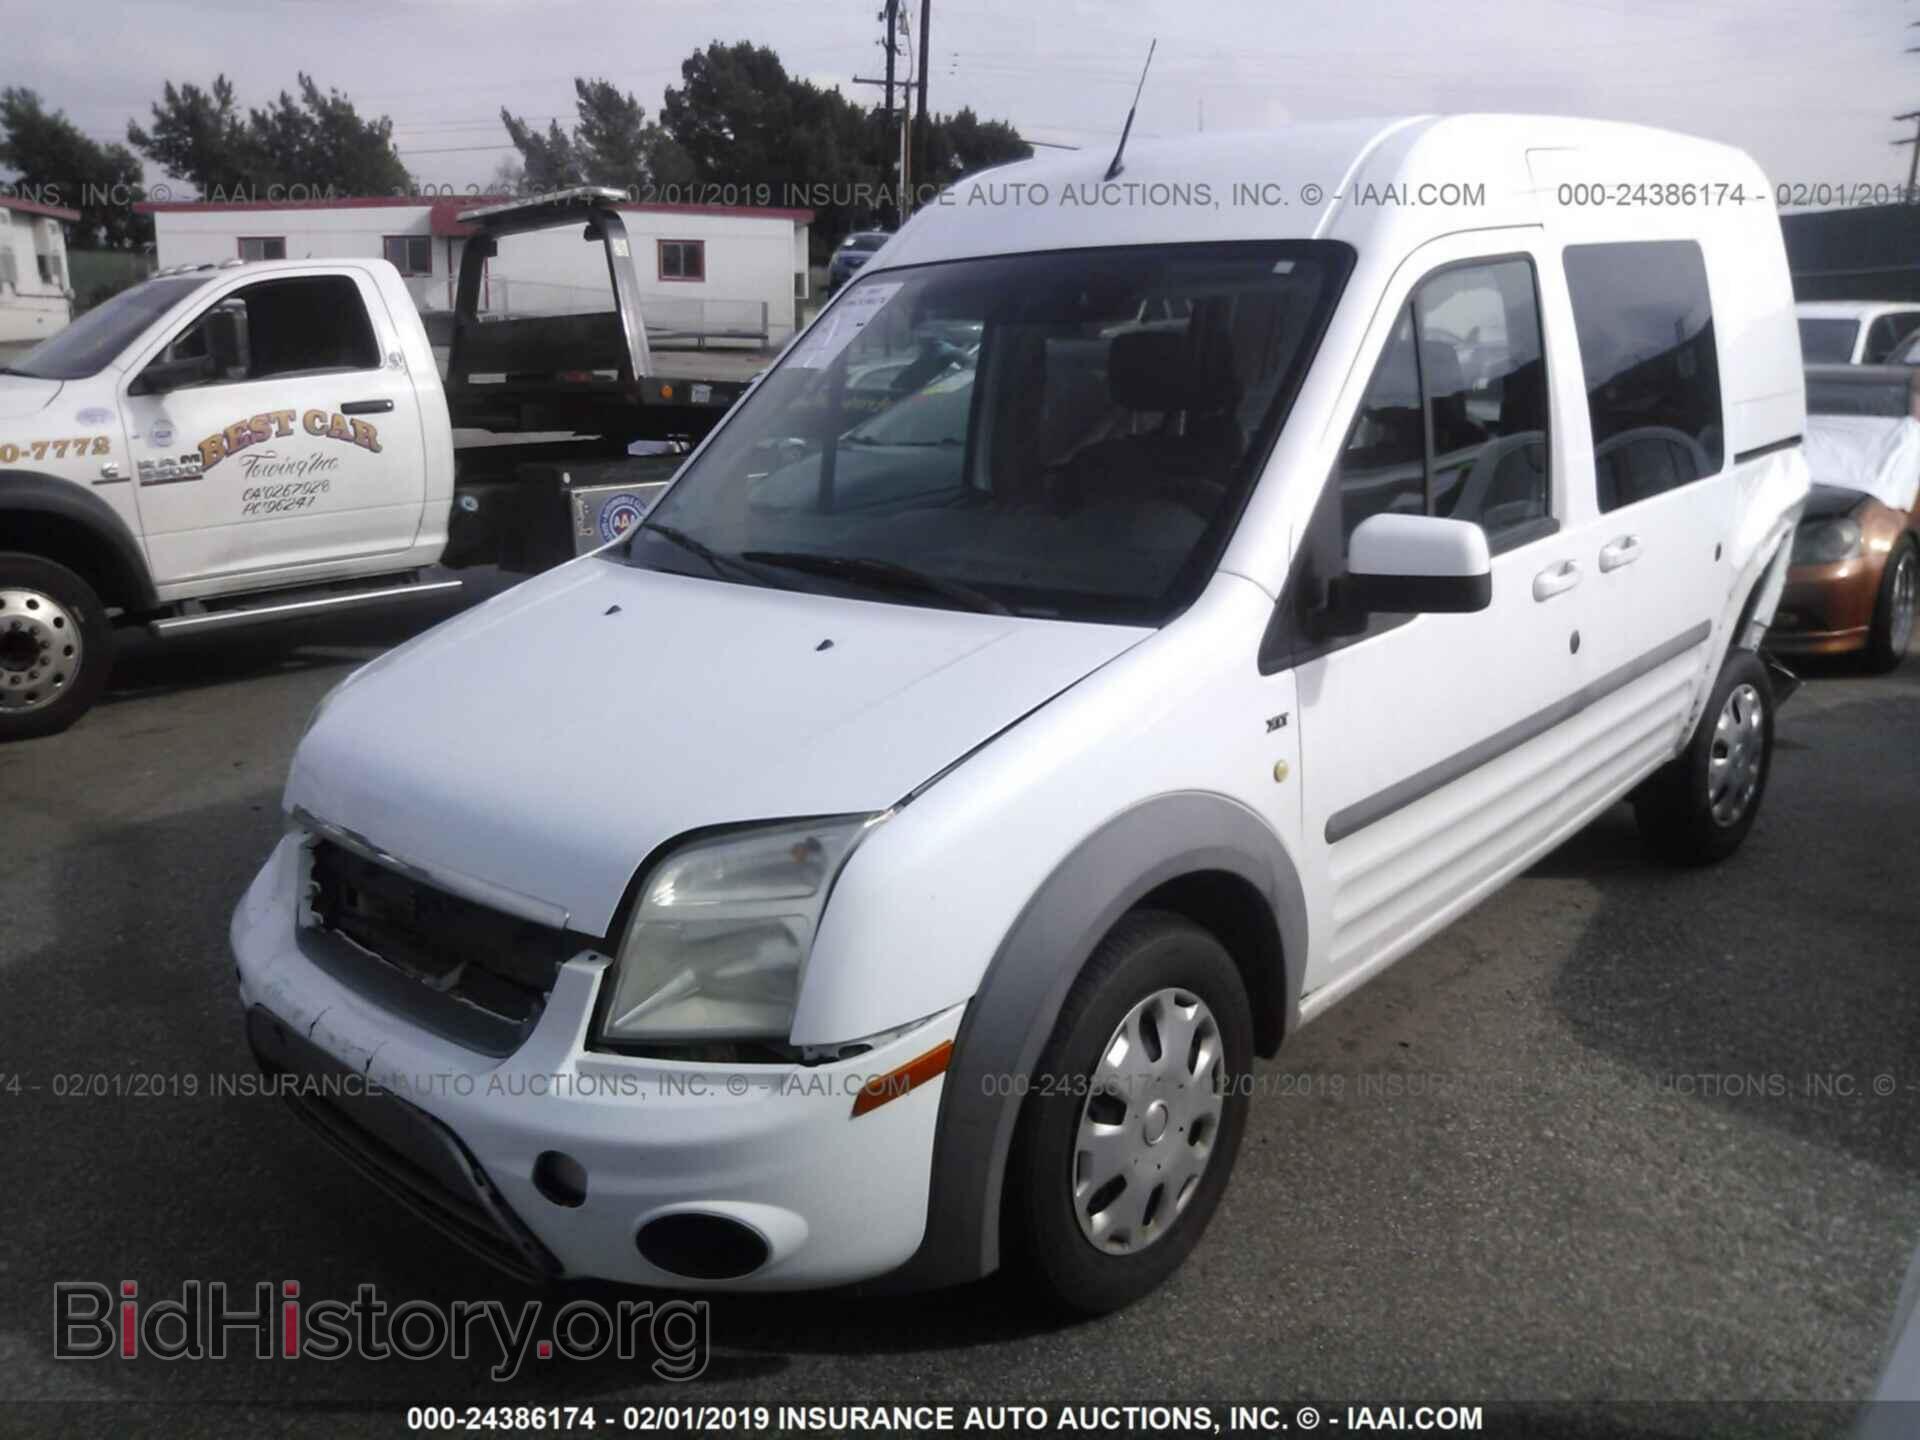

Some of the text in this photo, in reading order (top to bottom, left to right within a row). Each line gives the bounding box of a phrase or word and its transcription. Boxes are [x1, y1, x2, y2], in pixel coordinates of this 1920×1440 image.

[198, 409, 296, 472] BEST
[303, 409, 382, 453] CAR
[240, 450, 308, 480] Towing
